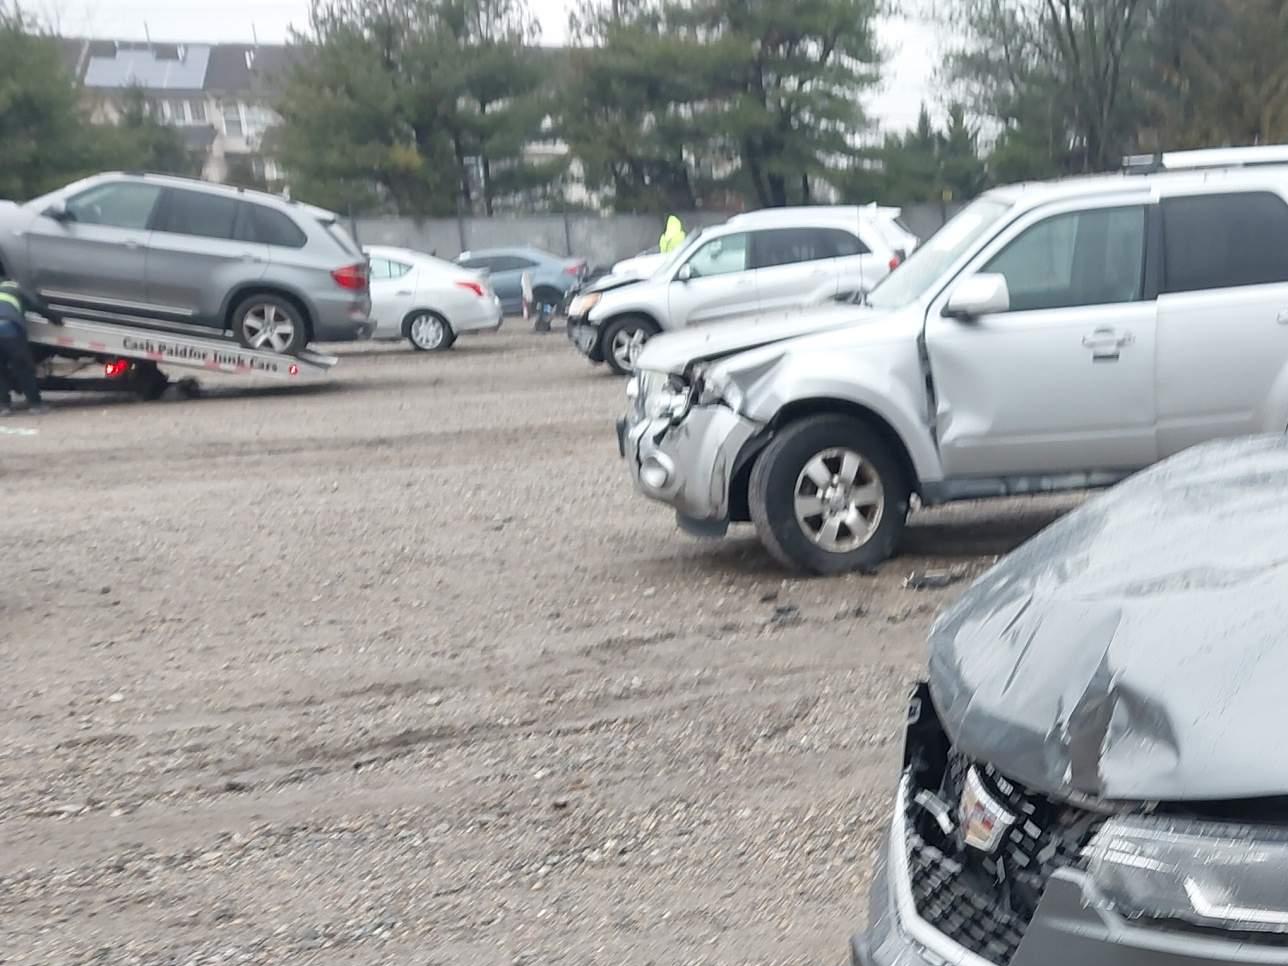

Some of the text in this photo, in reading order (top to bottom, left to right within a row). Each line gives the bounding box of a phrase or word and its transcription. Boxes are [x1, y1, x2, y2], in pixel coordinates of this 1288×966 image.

[123, 337, 154, 353] Cash
[213, 350, 245, 367] Junk
[250, 357, 279, 373] Cars
